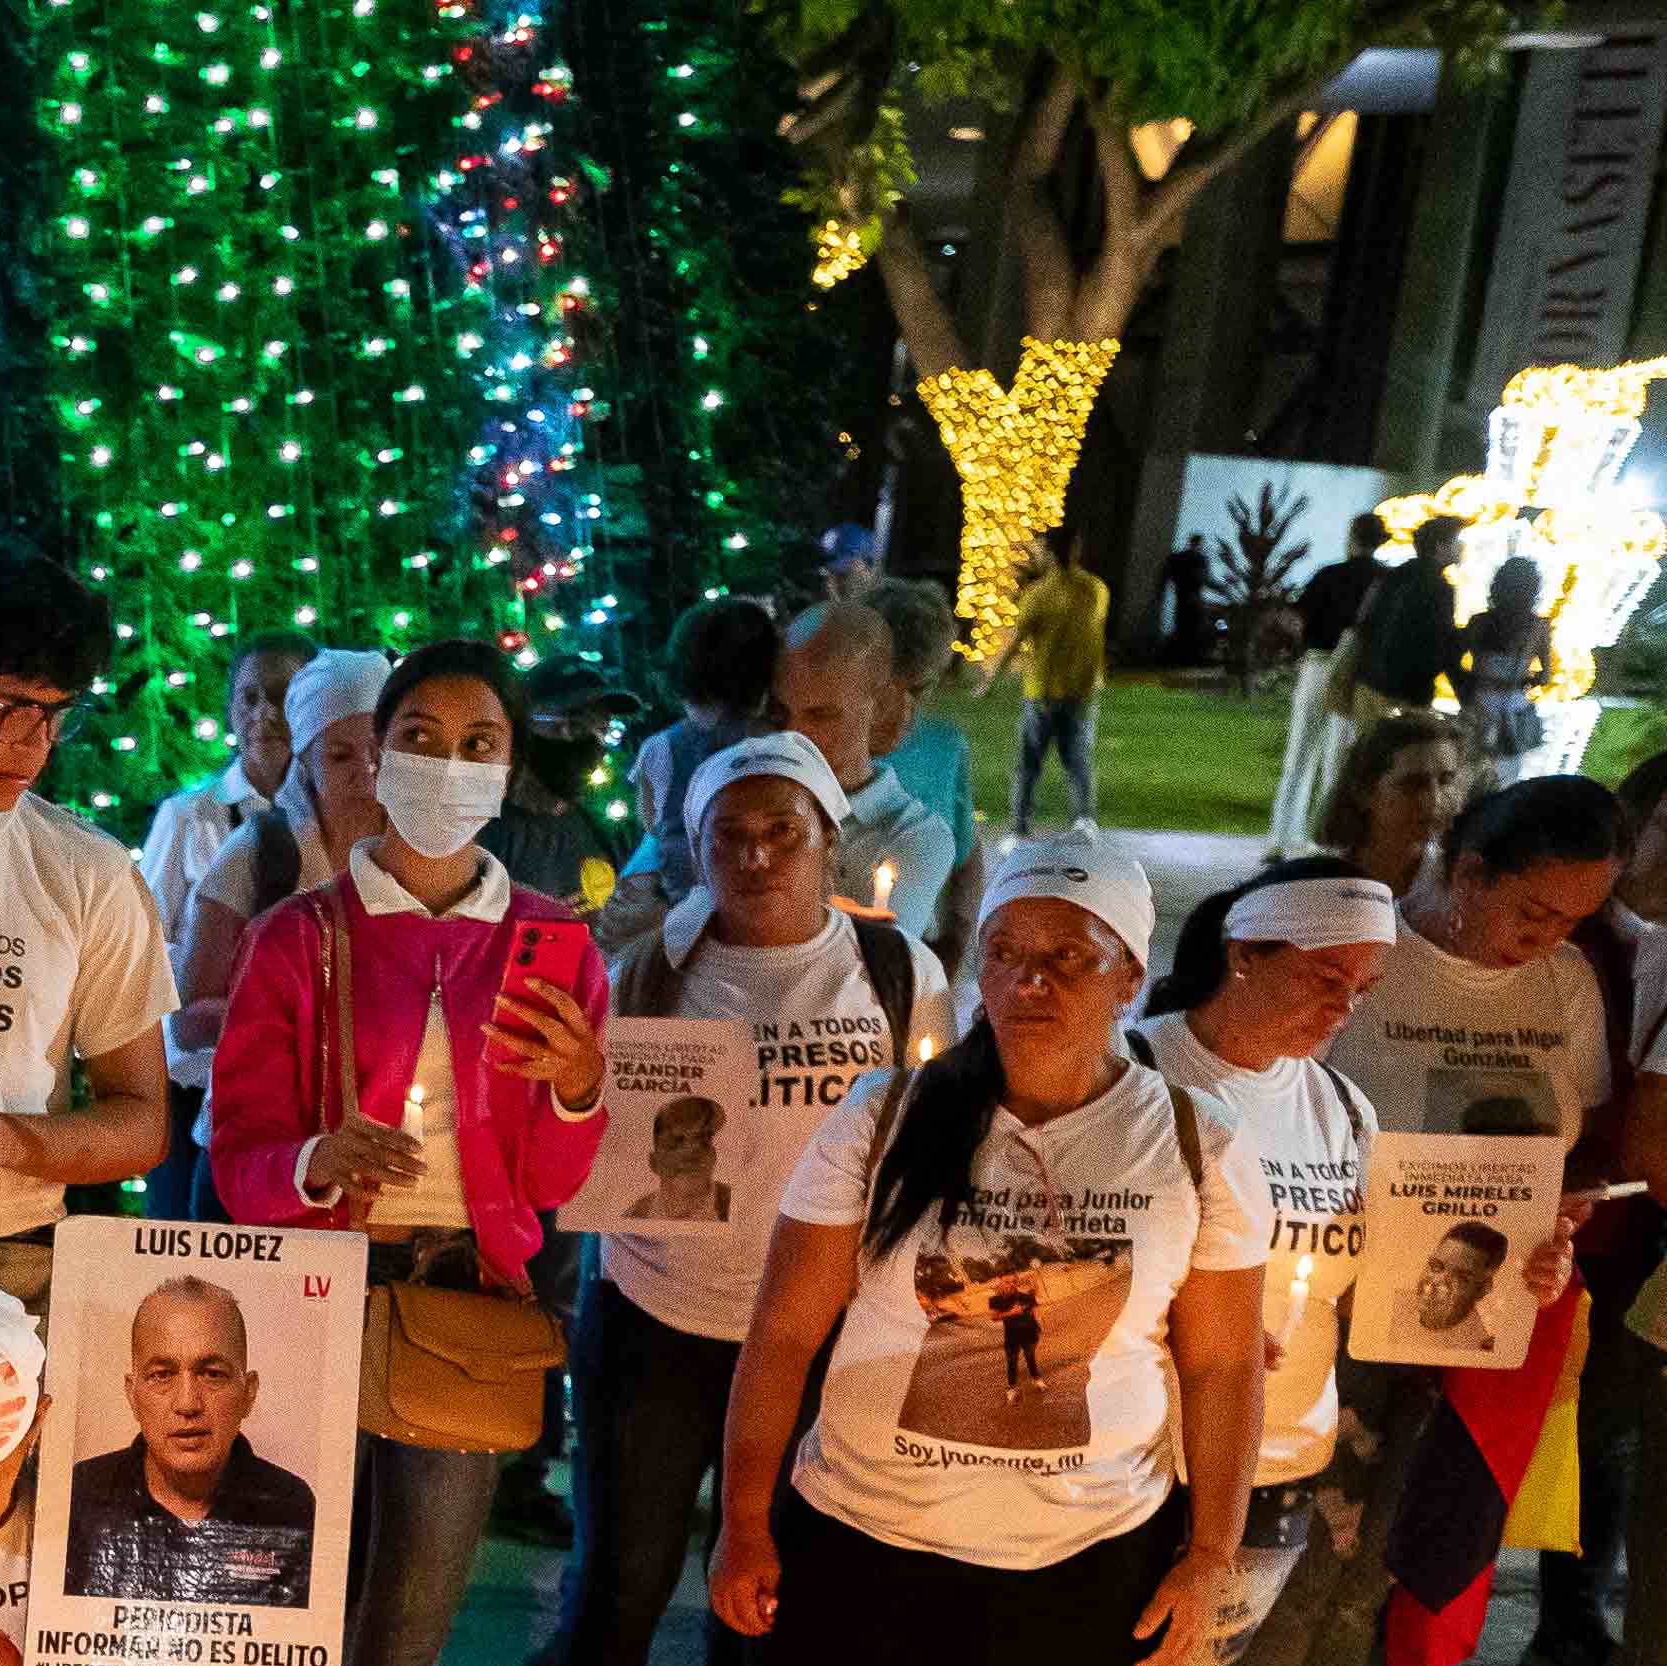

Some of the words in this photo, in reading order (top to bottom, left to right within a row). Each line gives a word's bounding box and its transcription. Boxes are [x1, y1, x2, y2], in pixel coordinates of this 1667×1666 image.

[788, 1021, 805, 1040] A
[809, 1016, 883, 1037] TODOS
[1384, 1020, 1467, 1044] Libertad
[1472, 1030, 1516, 1048] para
[757, 1040, 885, 1070] PRESOS
[612, 1061, 705, 1080] JEANDER
[1291, 1161, 1306, 1181] A
[1079, 1188, 1155, 1212] Junior
[1269, 1183, 1365, 1216] PRESO
[1390, 1182, 1437, 1199] LUIS
[1443, 1184, 1533, 1202] MIRELES
[1422, 1201, 1499, 1218] GRILLO
[134, 1227, 191, 1258] LUIS
[198, 1230, 284, 1262] LOPEZ
[303, 1275, 332, 1298] LV
[893, 1435, 940, 1467] Soy
[112, 1604, 253, 1637] PERIODISTA
[36, 1630, 161, 1660] INFORMAR
[167, 1636, 203, 1663] NO
[210, 1639, 236, 1665] ES
